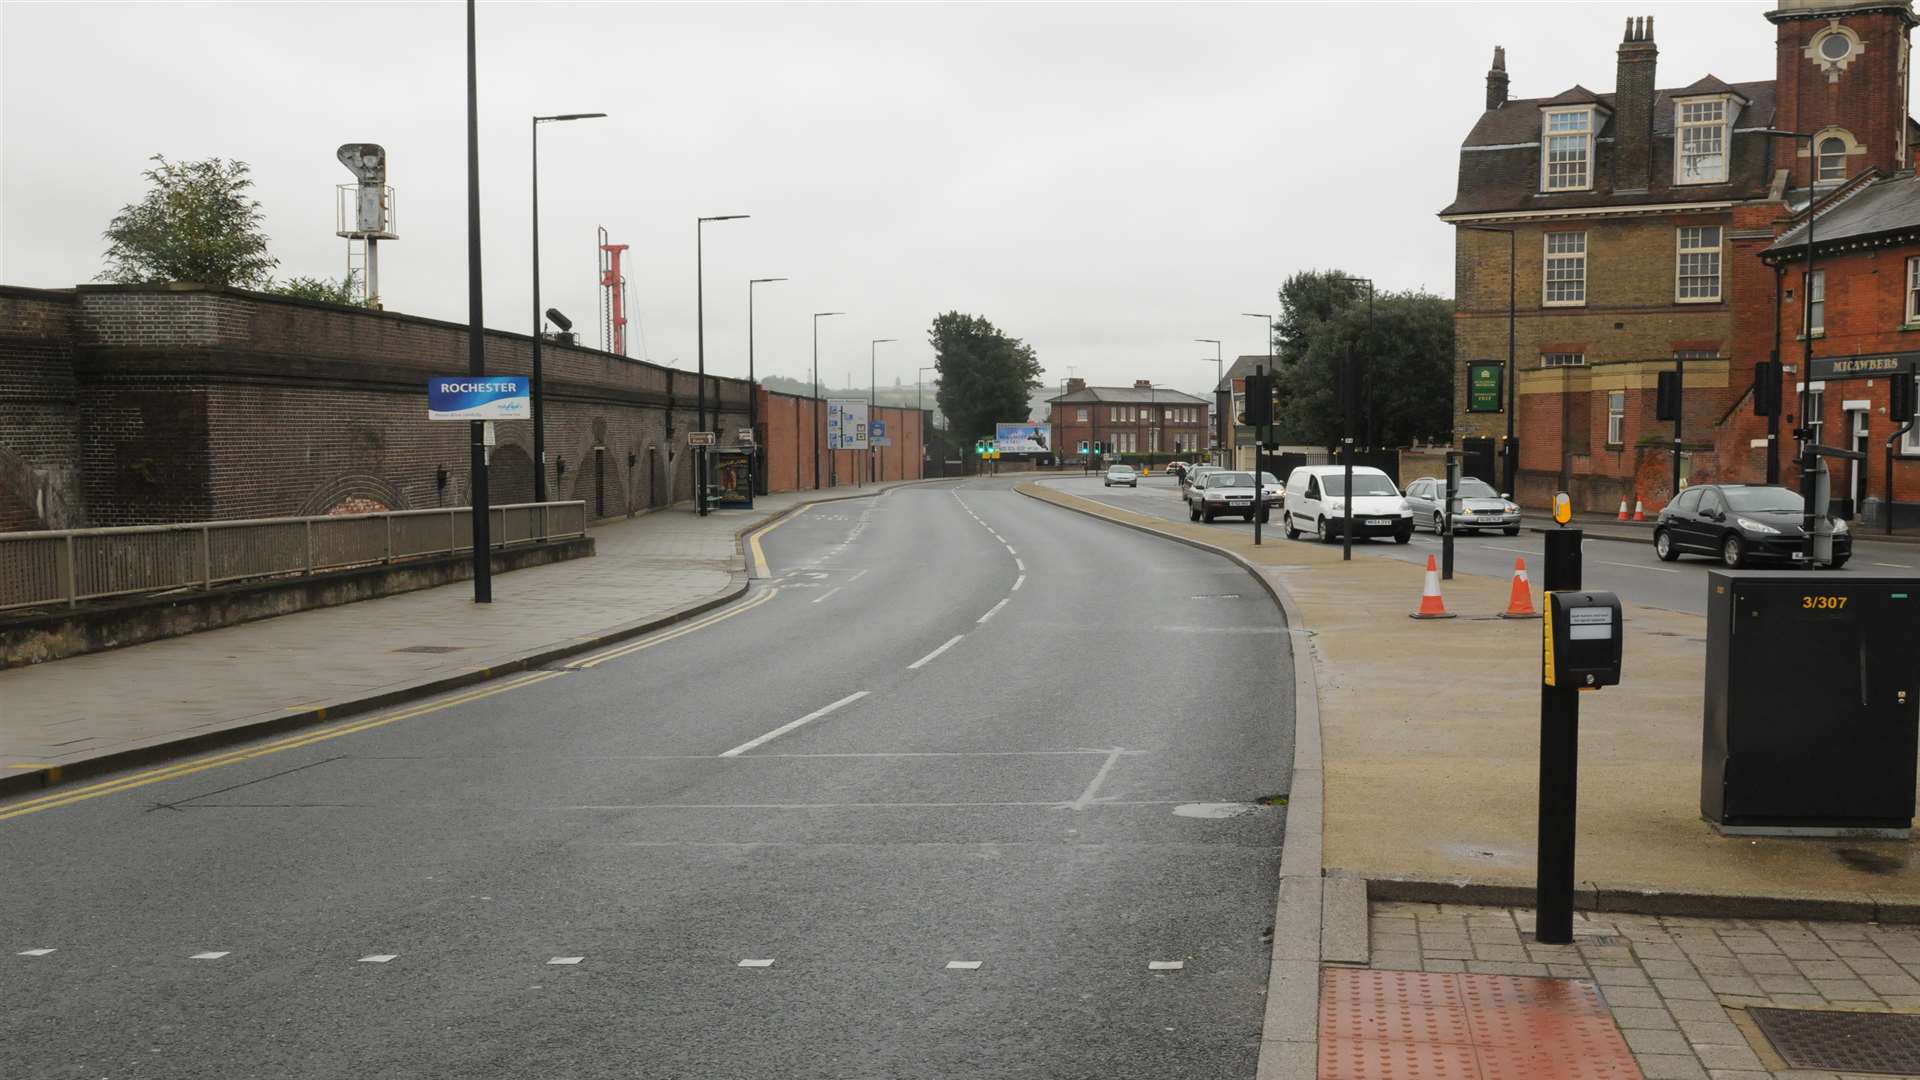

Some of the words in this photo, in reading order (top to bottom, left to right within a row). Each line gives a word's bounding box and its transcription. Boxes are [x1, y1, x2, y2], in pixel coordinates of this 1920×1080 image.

[1833, 358, 1898, 372] MICAWBERS
[441, 383, 517, 393] ROCHESTER
[1802, 596, 1848, 609] 3/307
